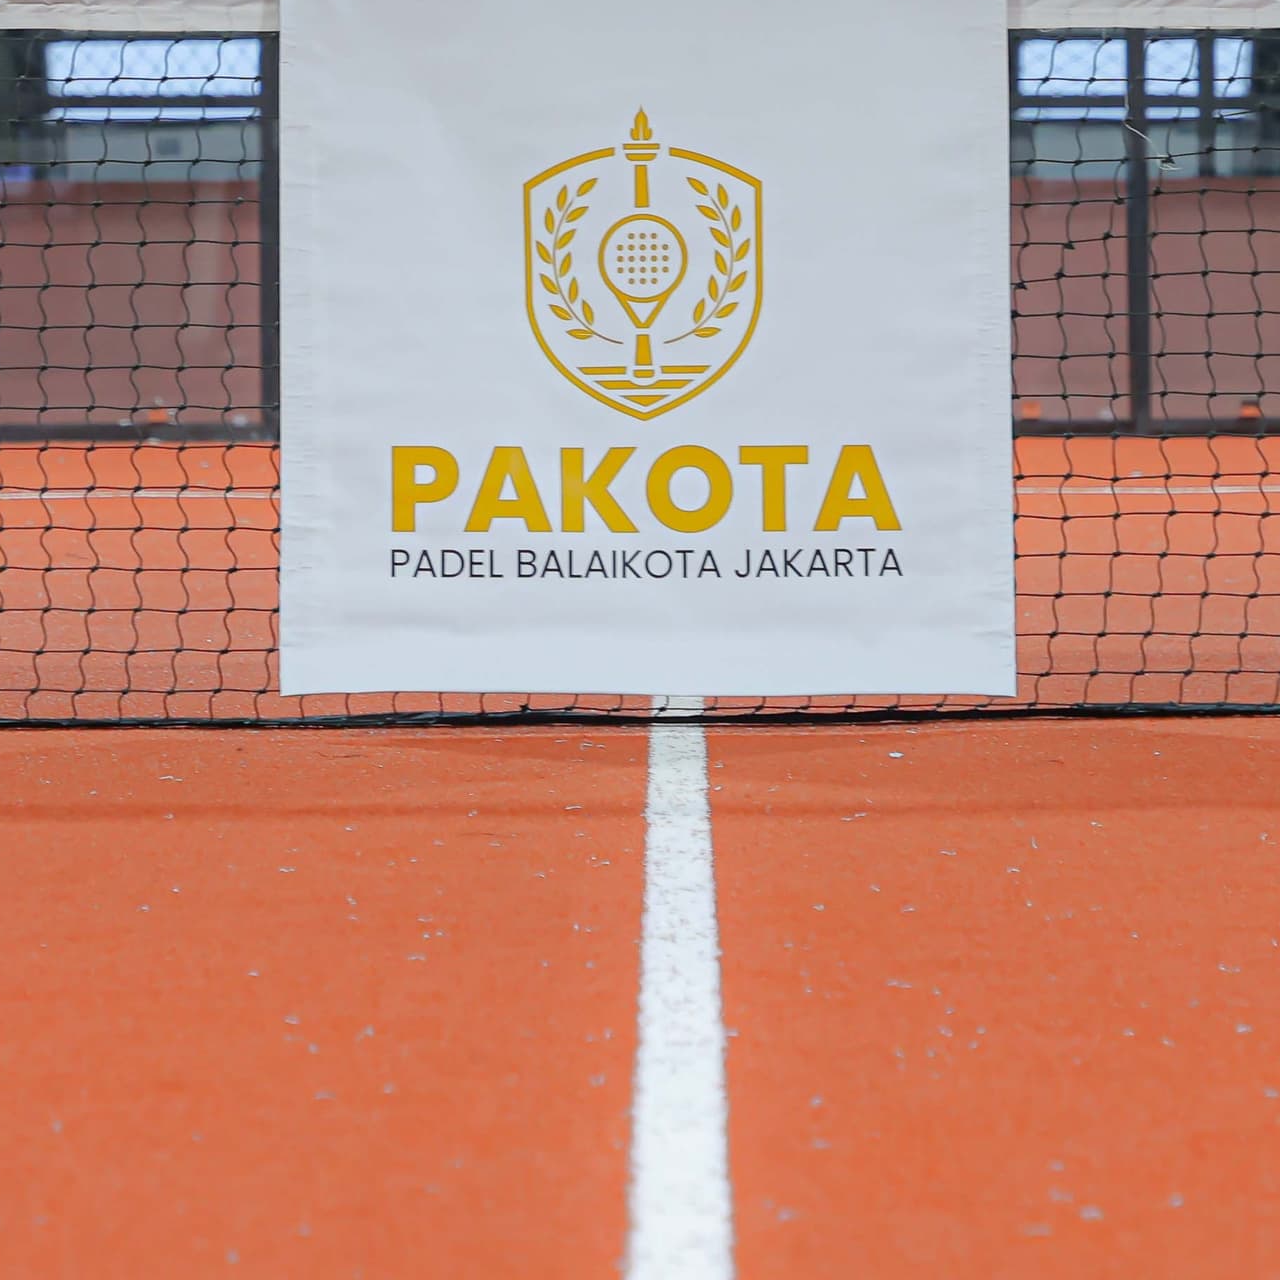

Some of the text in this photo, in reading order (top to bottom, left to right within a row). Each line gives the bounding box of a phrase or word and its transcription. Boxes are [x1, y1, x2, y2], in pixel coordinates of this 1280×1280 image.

[393, 445, 900, 533] PAKOTA
[392, 549, 902, 578] PADEL BALAIKOTA JAKARTA
